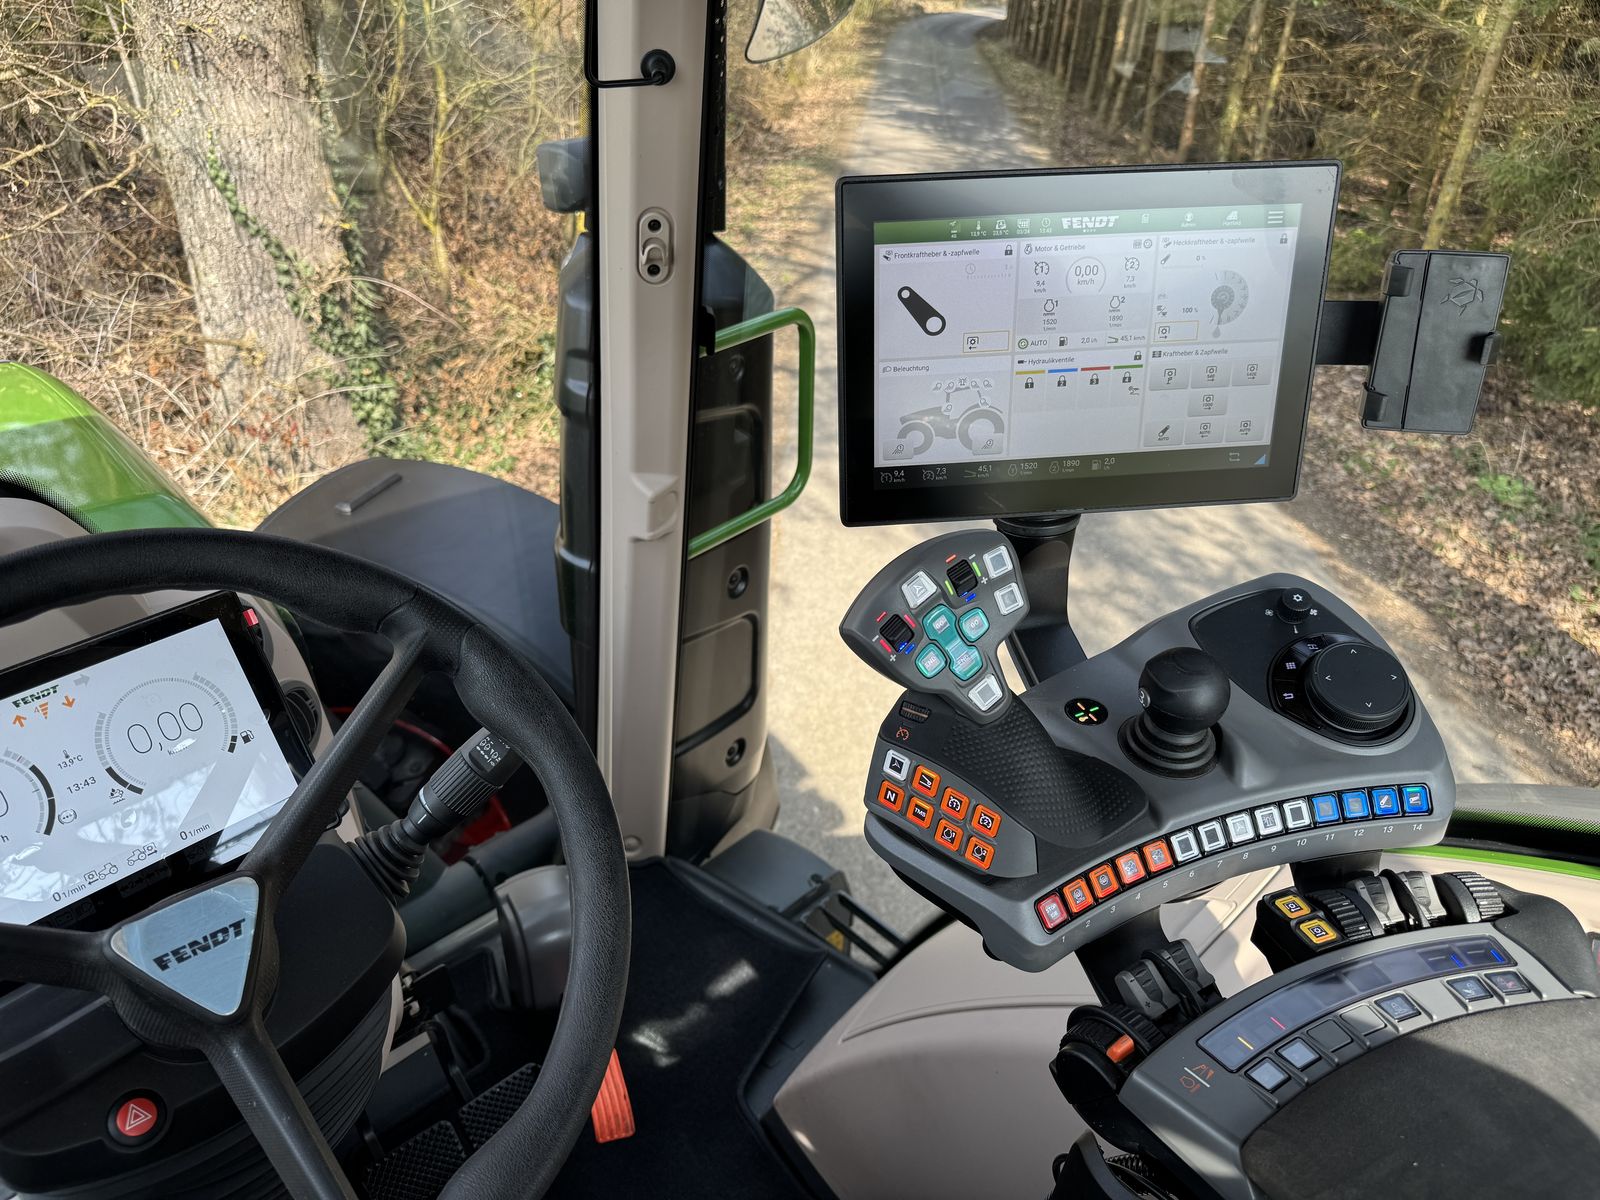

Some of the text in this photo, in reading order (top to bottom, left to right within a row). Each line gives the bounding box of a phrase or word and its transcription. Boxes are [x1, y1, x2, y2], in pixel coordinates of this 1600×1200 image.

[1061, 215, 1119, 229] FENDT
[1173, 238, 1218, 246] Heckkraftheber
[1059, 243, 1086, 252] Getriebe
[894, 250, 941, 259] Frontkraftheber
[948, 248, 980, 257] -zapfwelle
[1074, 264, 1099, 277] 0,00
[1077, 277, 1095, 285] km/h
[1042, 318, 1058, 326] 1520
[1200, 348, 1228, 356] Zapfwelle
[1028, 356, 1075, 366] Hydraulikventile
[893, 364, 930, 374] Beleuchtung
[1062, 459, 1080, 467] 1890
[1104, 457, 1116, 465] 2,0
[977, 464, 992, 473] 45,1
[1020, 462, 1038, 470] 1520
[894, 469, 905, 478] 9,4
[936, 467, 947, 476] 7,3
[11, 684, 59, 708] FENDT
[127, 702, 204, 754] 0,00
[66, 776, 97, 794] 13:43
[886, 790, 896, 802] N
[914, 807, 927, 818] TMS
[179, 823, 211, 841] 0 1/min
[1382, 825, 1394, 834] 13
[1412, 823, 1423, 832] 14
[1324, 832, 1335, 841] 11
[1353, 829, 1365, 837] 12
[1296, 838, 1307, 847] 10
[1270, 845, 1277, 853] 9
[1242, 852, 1249, 860] 8
[1217, 860, 1222, 868] 7
[1189, 870, 1195, 878] 6
[1162, 880, 1169, 888] 5
[52, 882, 86, 902] 0 1/min
[1135, 892, 1141, 900] 4
[1045, 903, 1057, 914] STOP
[1110, 905, 1116, 913] 3
[1086, 920, 1091, 928] 2
[152, 918, 246, 971] FENDT
